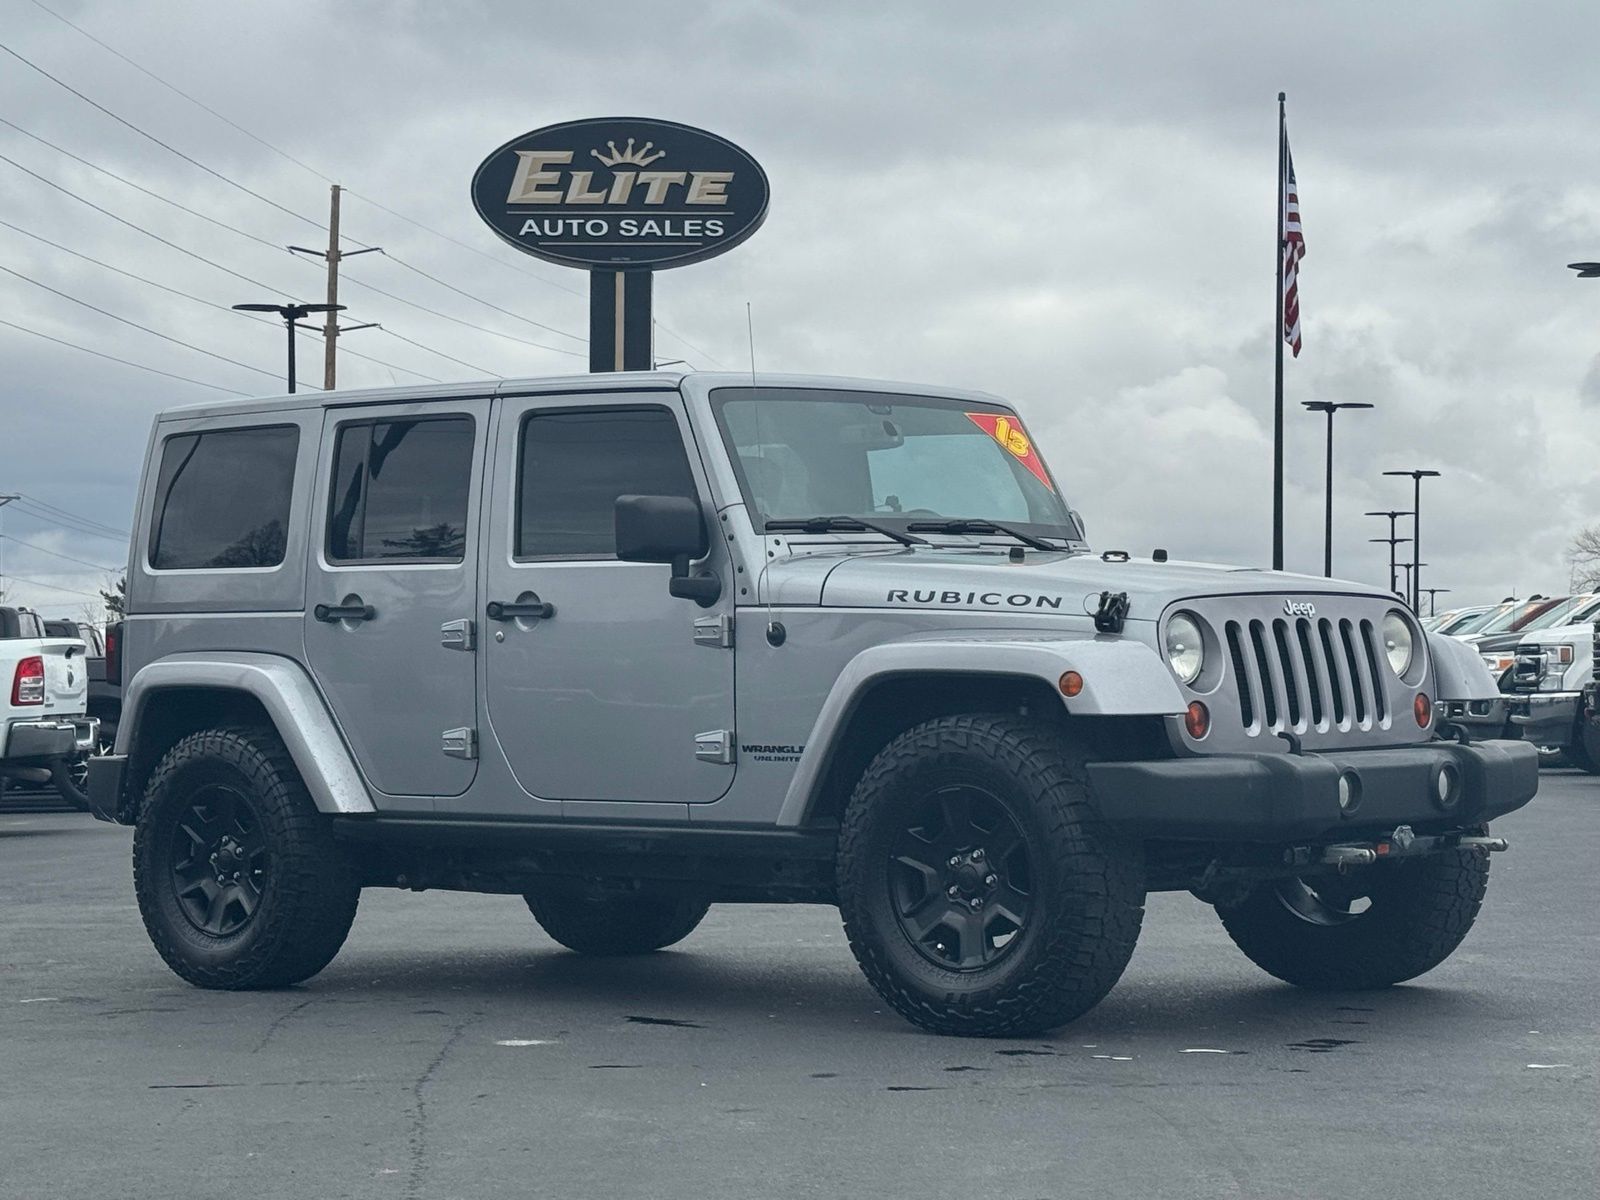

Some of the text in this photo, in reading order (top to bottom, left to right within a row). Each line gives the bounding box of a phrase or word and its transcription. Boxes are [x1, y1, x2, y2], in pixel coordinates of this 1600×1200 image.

[518, 219, 725, 237] AUTO SALES
[887, 589, 1063, 609] RUBICON
[1283, 599, 1316, 619] Jeep
[741, 745, 806, 754] WRANGLE
[753, 755, 801, 763] UNLIMITE
